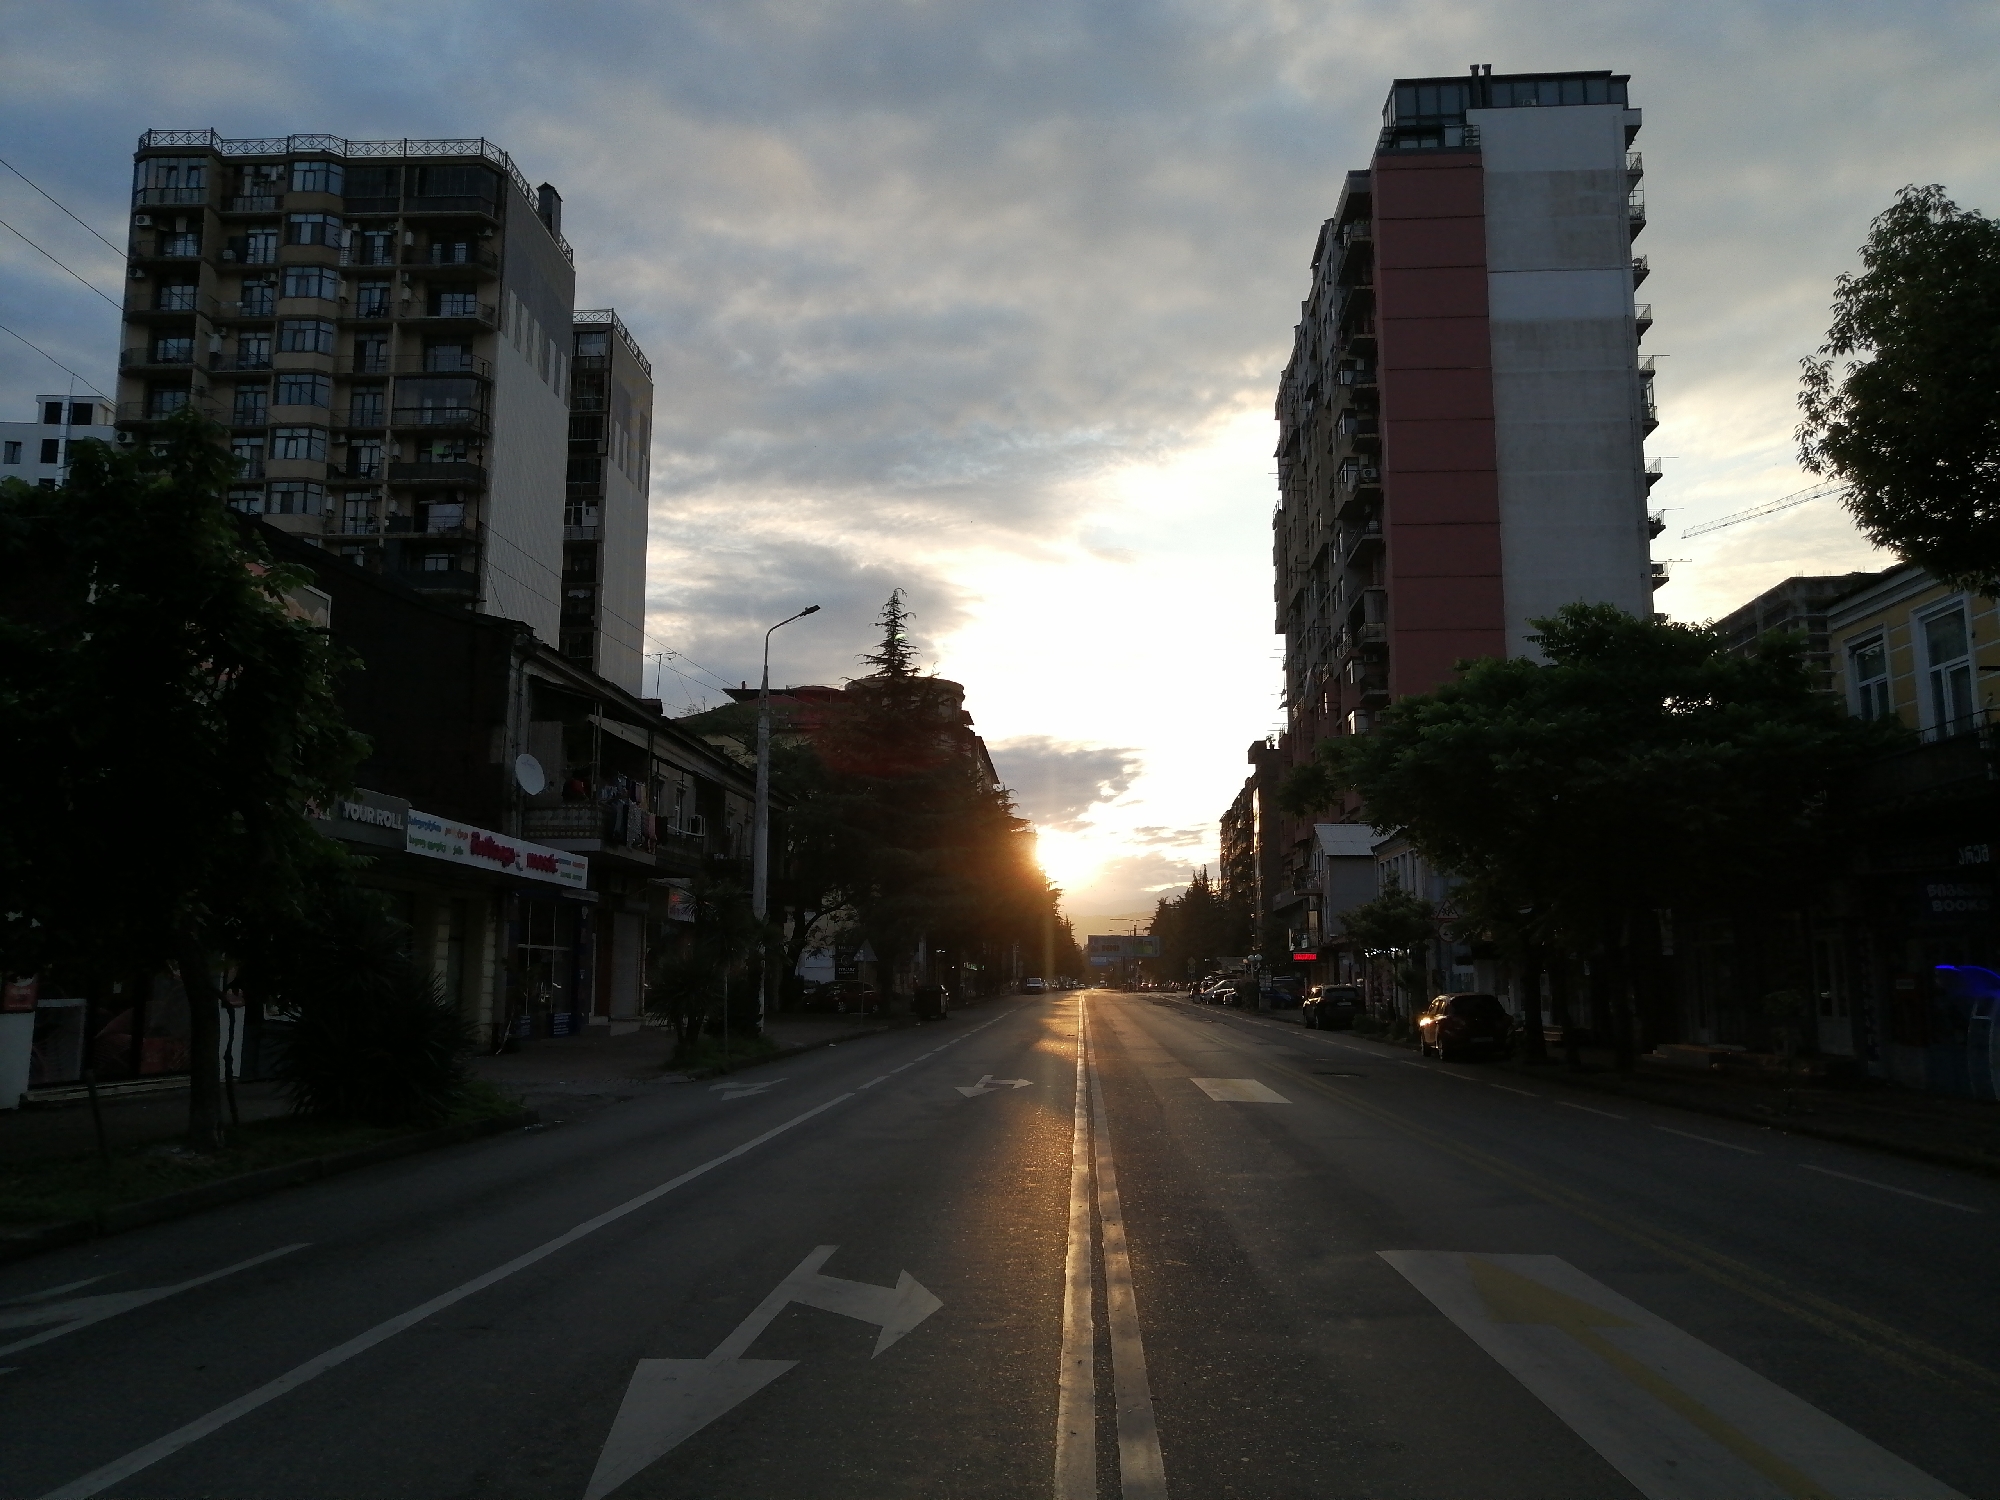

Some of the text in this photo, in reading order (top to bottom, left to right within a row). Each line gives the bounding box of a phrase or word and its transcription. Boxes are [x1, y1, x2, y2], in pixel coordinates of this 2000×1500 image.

[343, 801, 375, 824] YOUR
[376, 809, 404, 831] ROLL
[1931, 899, 1990, 912] BOOKS
